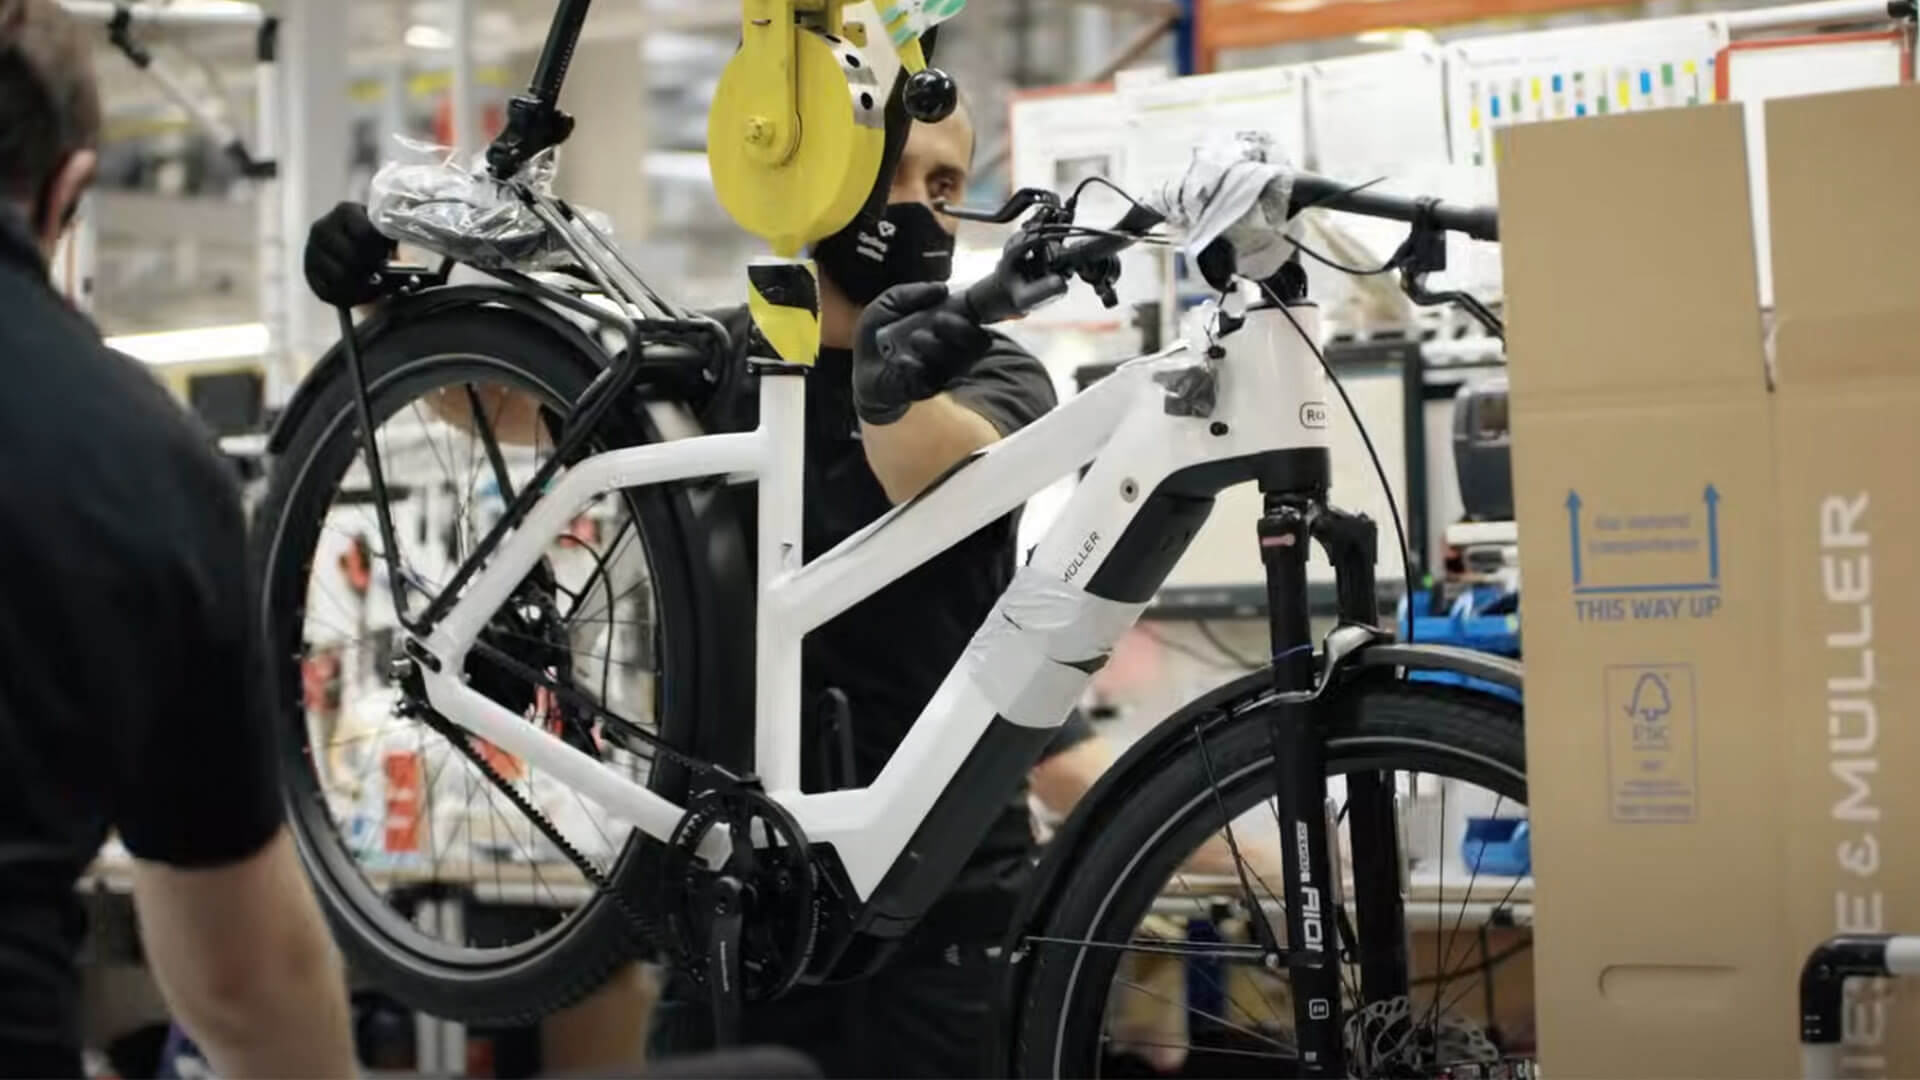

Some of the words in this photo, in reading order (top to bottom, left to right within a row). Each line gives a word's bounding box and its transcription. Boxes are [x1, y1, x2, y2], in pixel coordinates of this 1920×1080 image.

[1060, 531, 1101, 583] MÜLLER
[1574, 599, 1625, 622] THIS
[1632, 597, 1681, 620] WAY
[1690, 594, 1721, 618] UP
[1820, 490, 1880, 821] MÜLLER
[1837, 833, 1880, 876] &
[1836, 891, 1887, 1080] IEE
